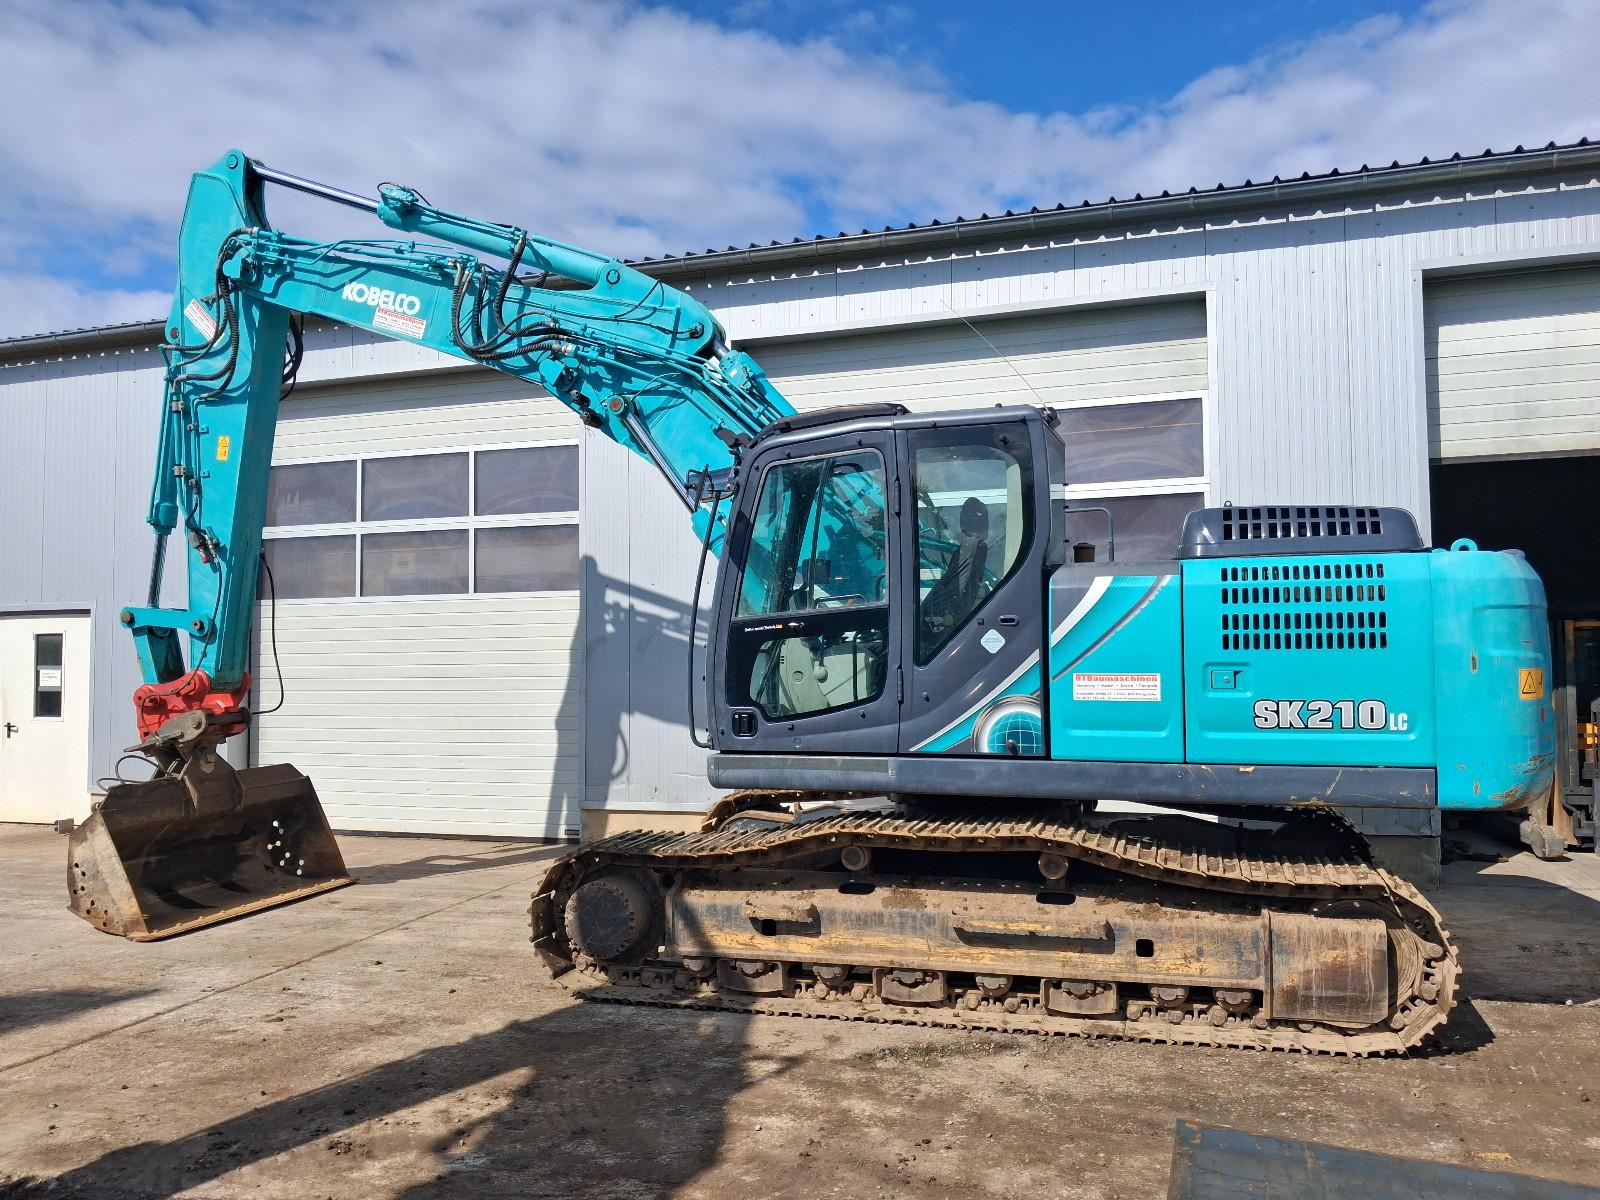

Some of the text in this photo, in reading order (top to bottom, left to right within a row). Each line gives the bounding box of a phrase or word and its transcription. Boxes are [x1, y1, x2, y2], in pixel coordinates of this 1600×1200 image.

[341, 281, 421, 315] KOBELCO
[1253, 699, 1408, 731] SK210 LC
